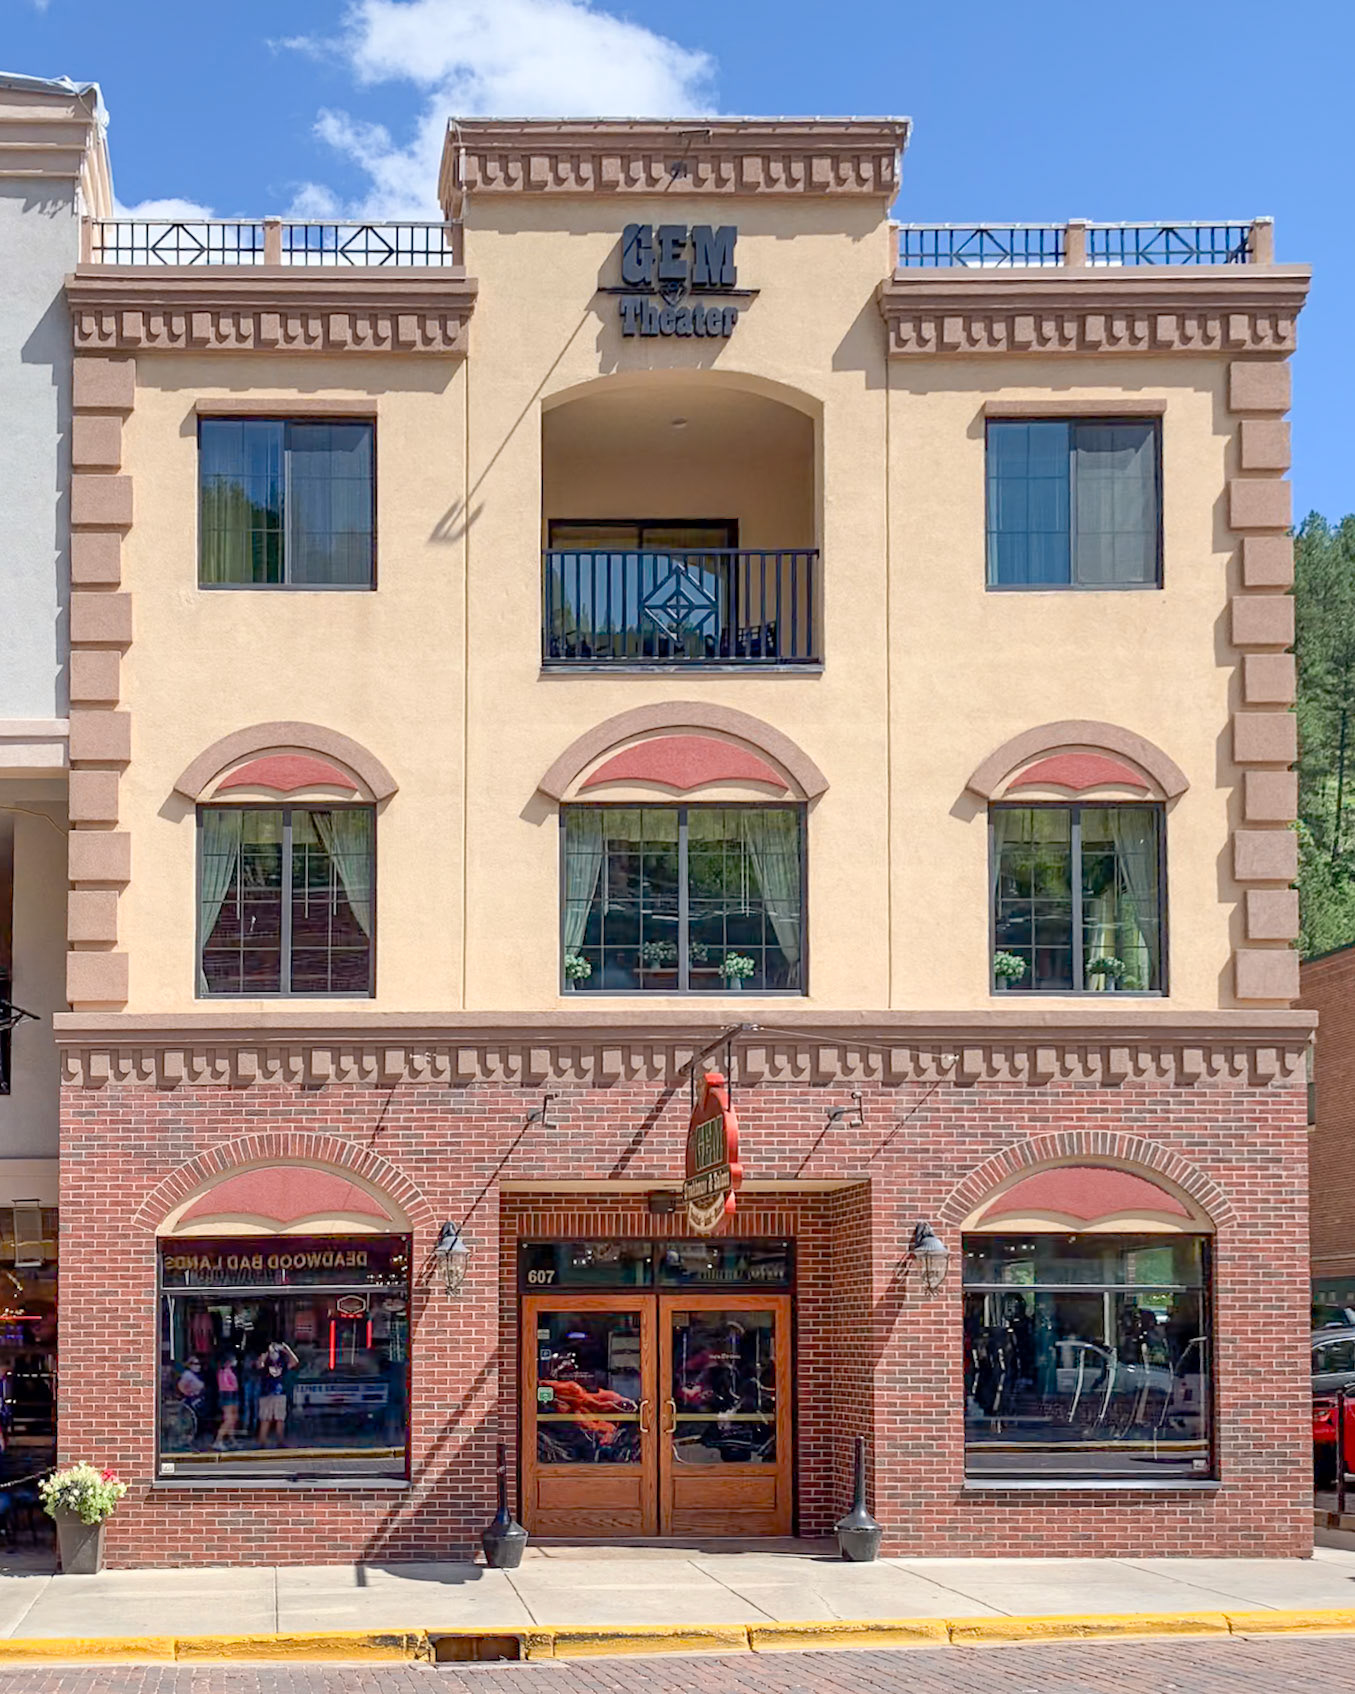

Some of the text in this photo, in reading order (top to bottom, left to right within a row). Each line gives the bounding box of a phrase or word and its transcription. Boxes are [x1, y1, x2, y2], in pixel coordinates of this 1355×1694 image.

[622, 223, 738, 287] GEM
[619, 295, 738, 338] Theater
[528, 1269, 555, 1284] 607
